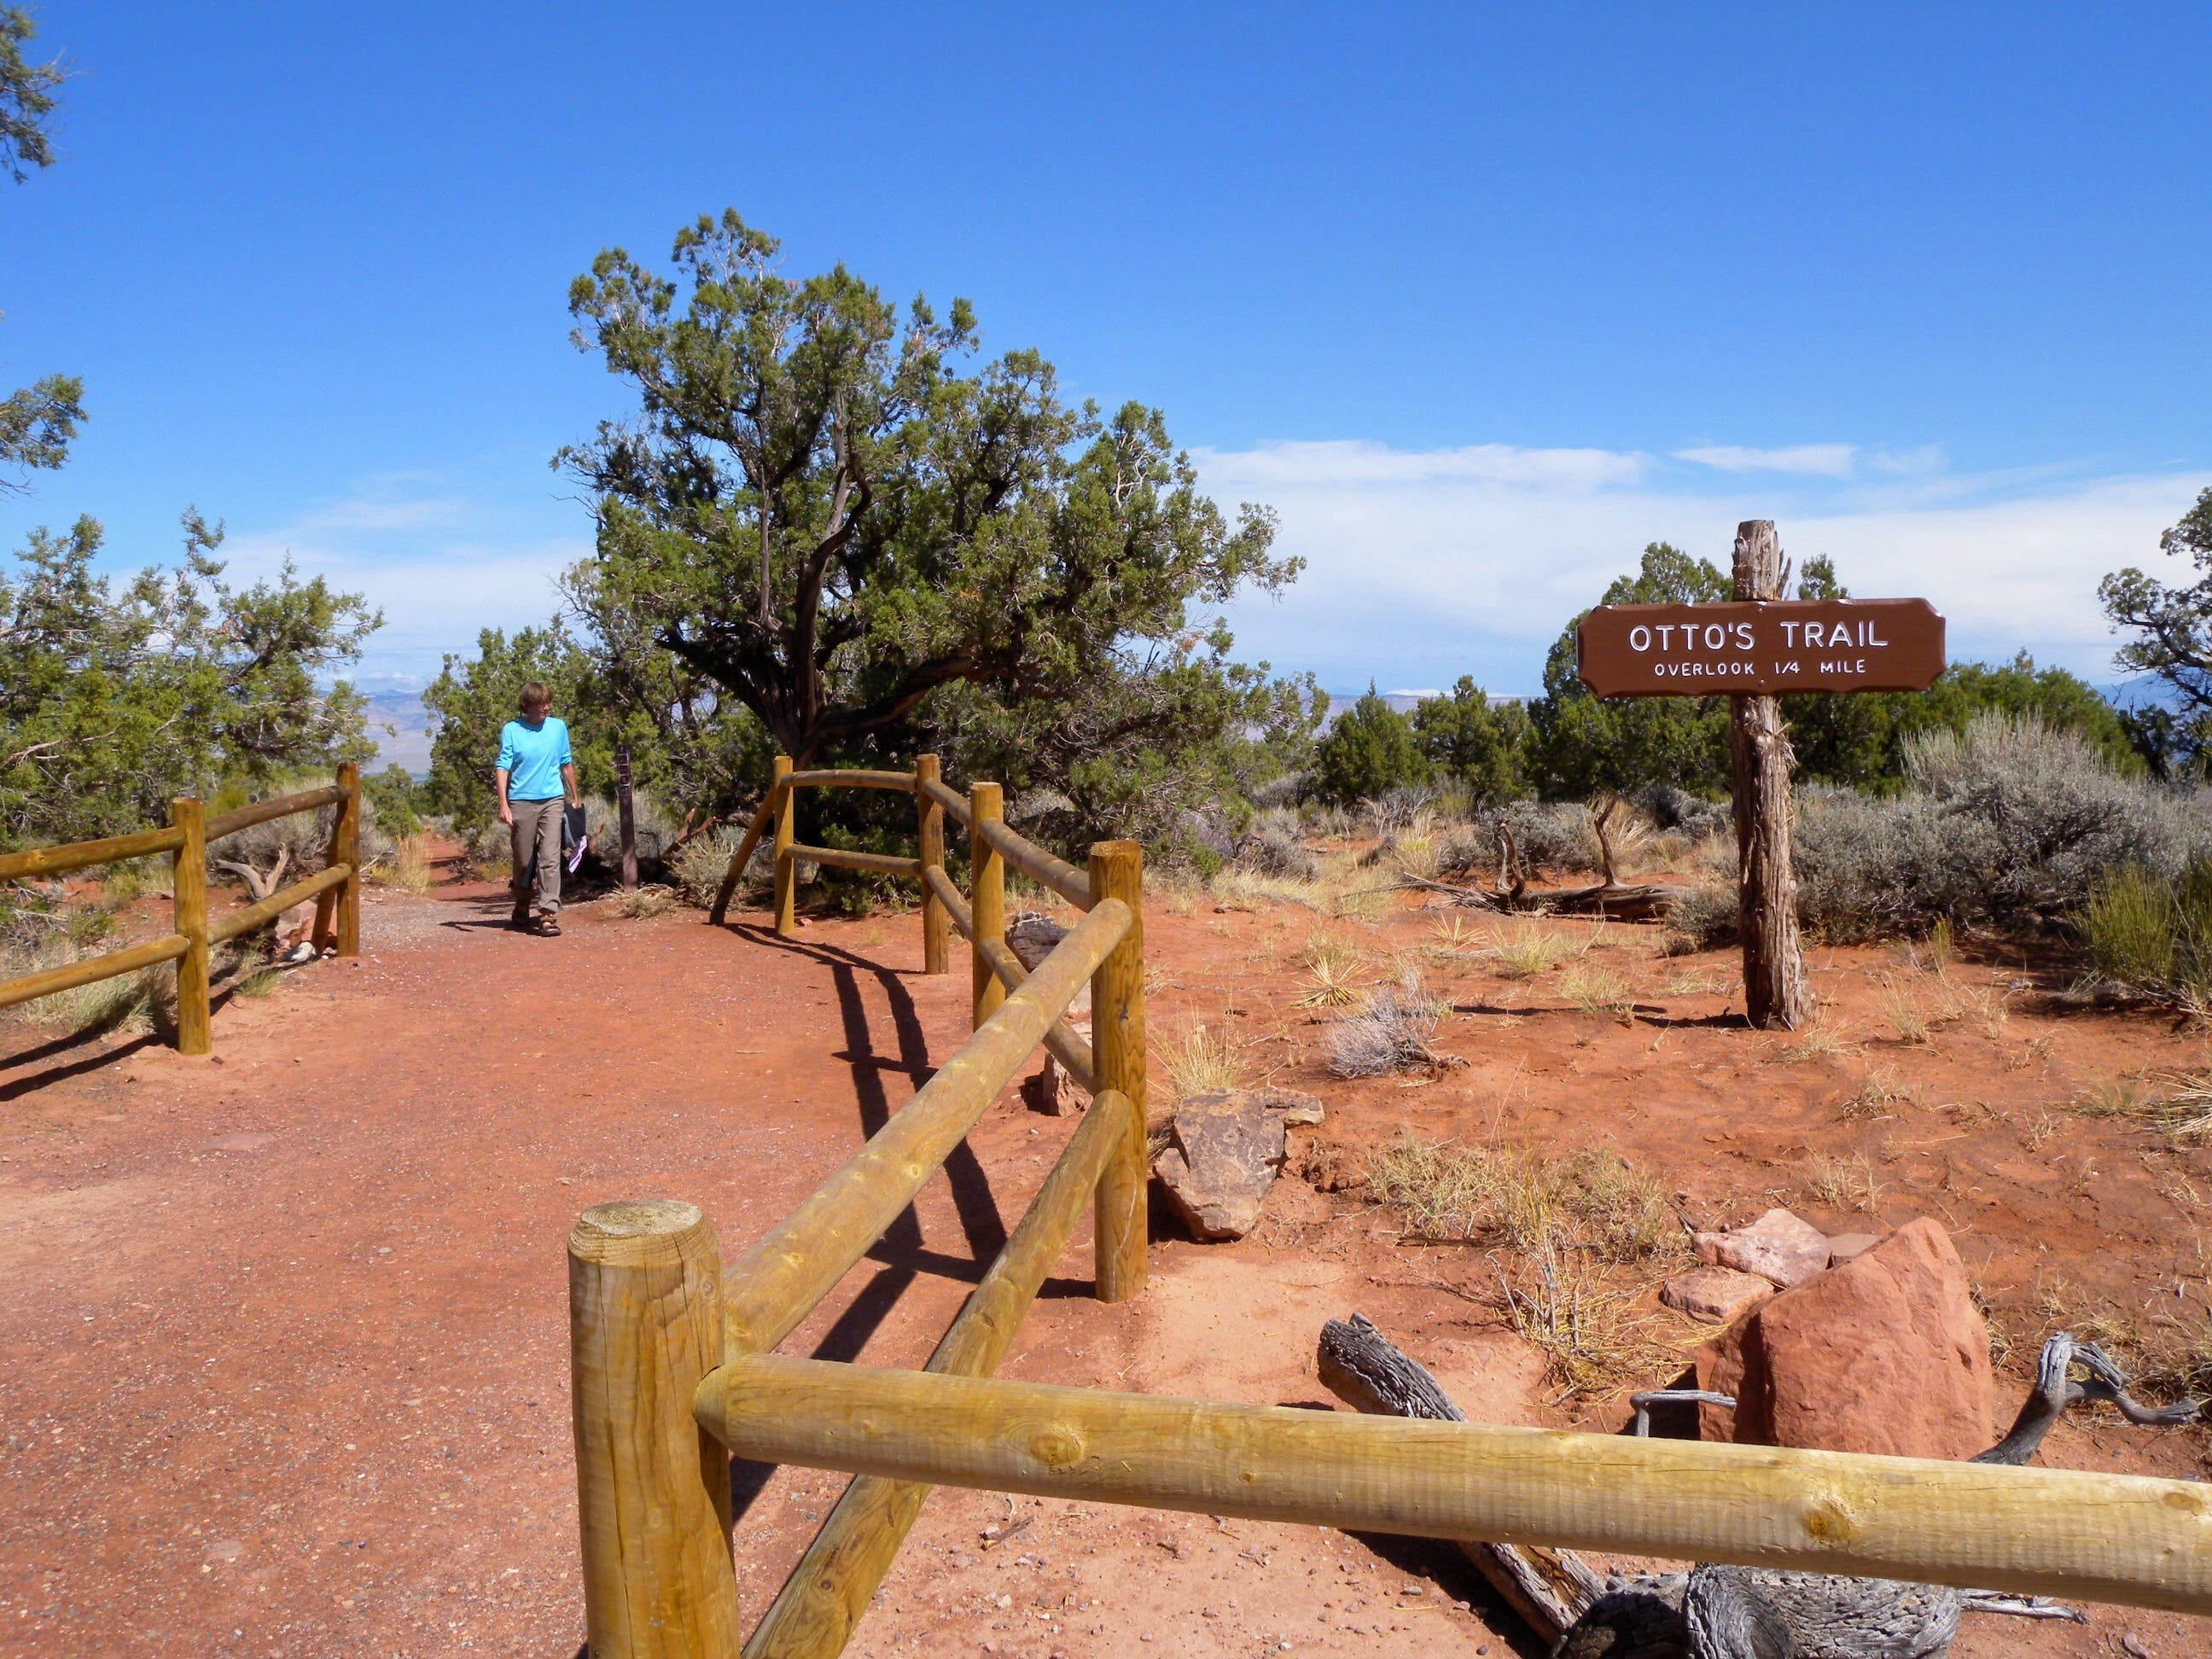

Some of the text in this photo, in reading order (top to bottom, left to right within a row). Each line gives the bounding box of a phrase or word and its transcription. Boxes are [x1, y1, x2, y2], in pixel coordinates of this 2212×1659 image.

[1629, 620, 1889, 652] OTTO'S TRAIL
[1654, 659, 1866, 677] OVERLOOK 1/4 MILE
